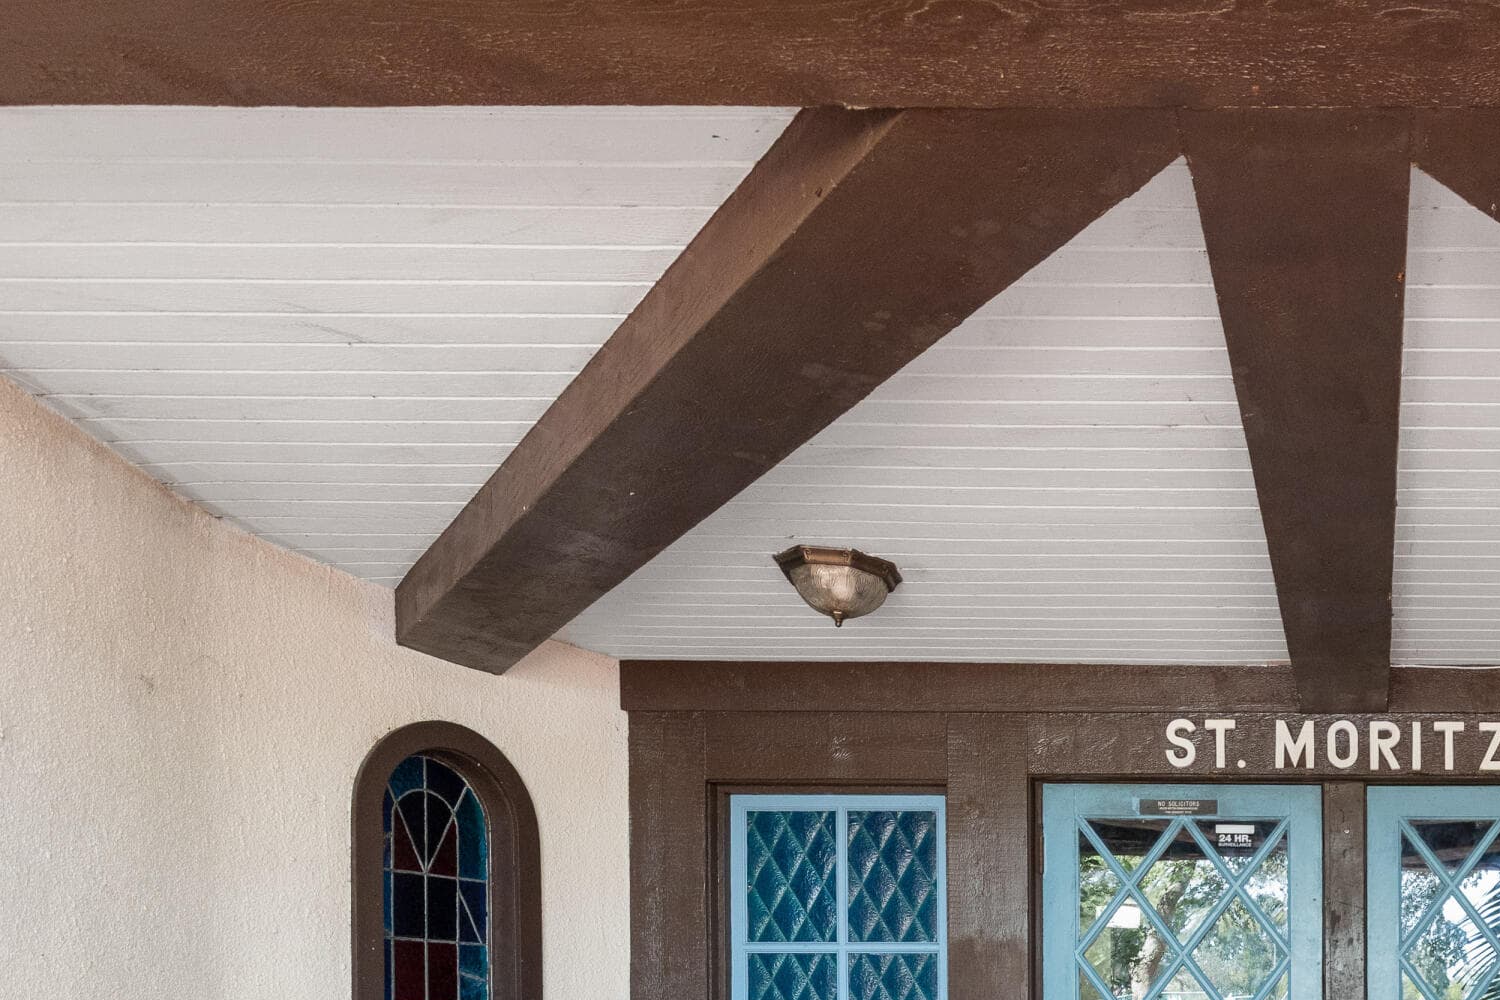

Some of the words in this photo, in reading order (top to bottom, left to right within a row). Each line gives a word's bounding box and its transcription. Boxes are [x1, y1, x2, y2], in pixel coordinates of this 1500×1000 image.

[1165, 718, 1247, 770] ST.
[1218, 834, 1232, 843] 24
[1234, 834, 1252, 843] HR.
